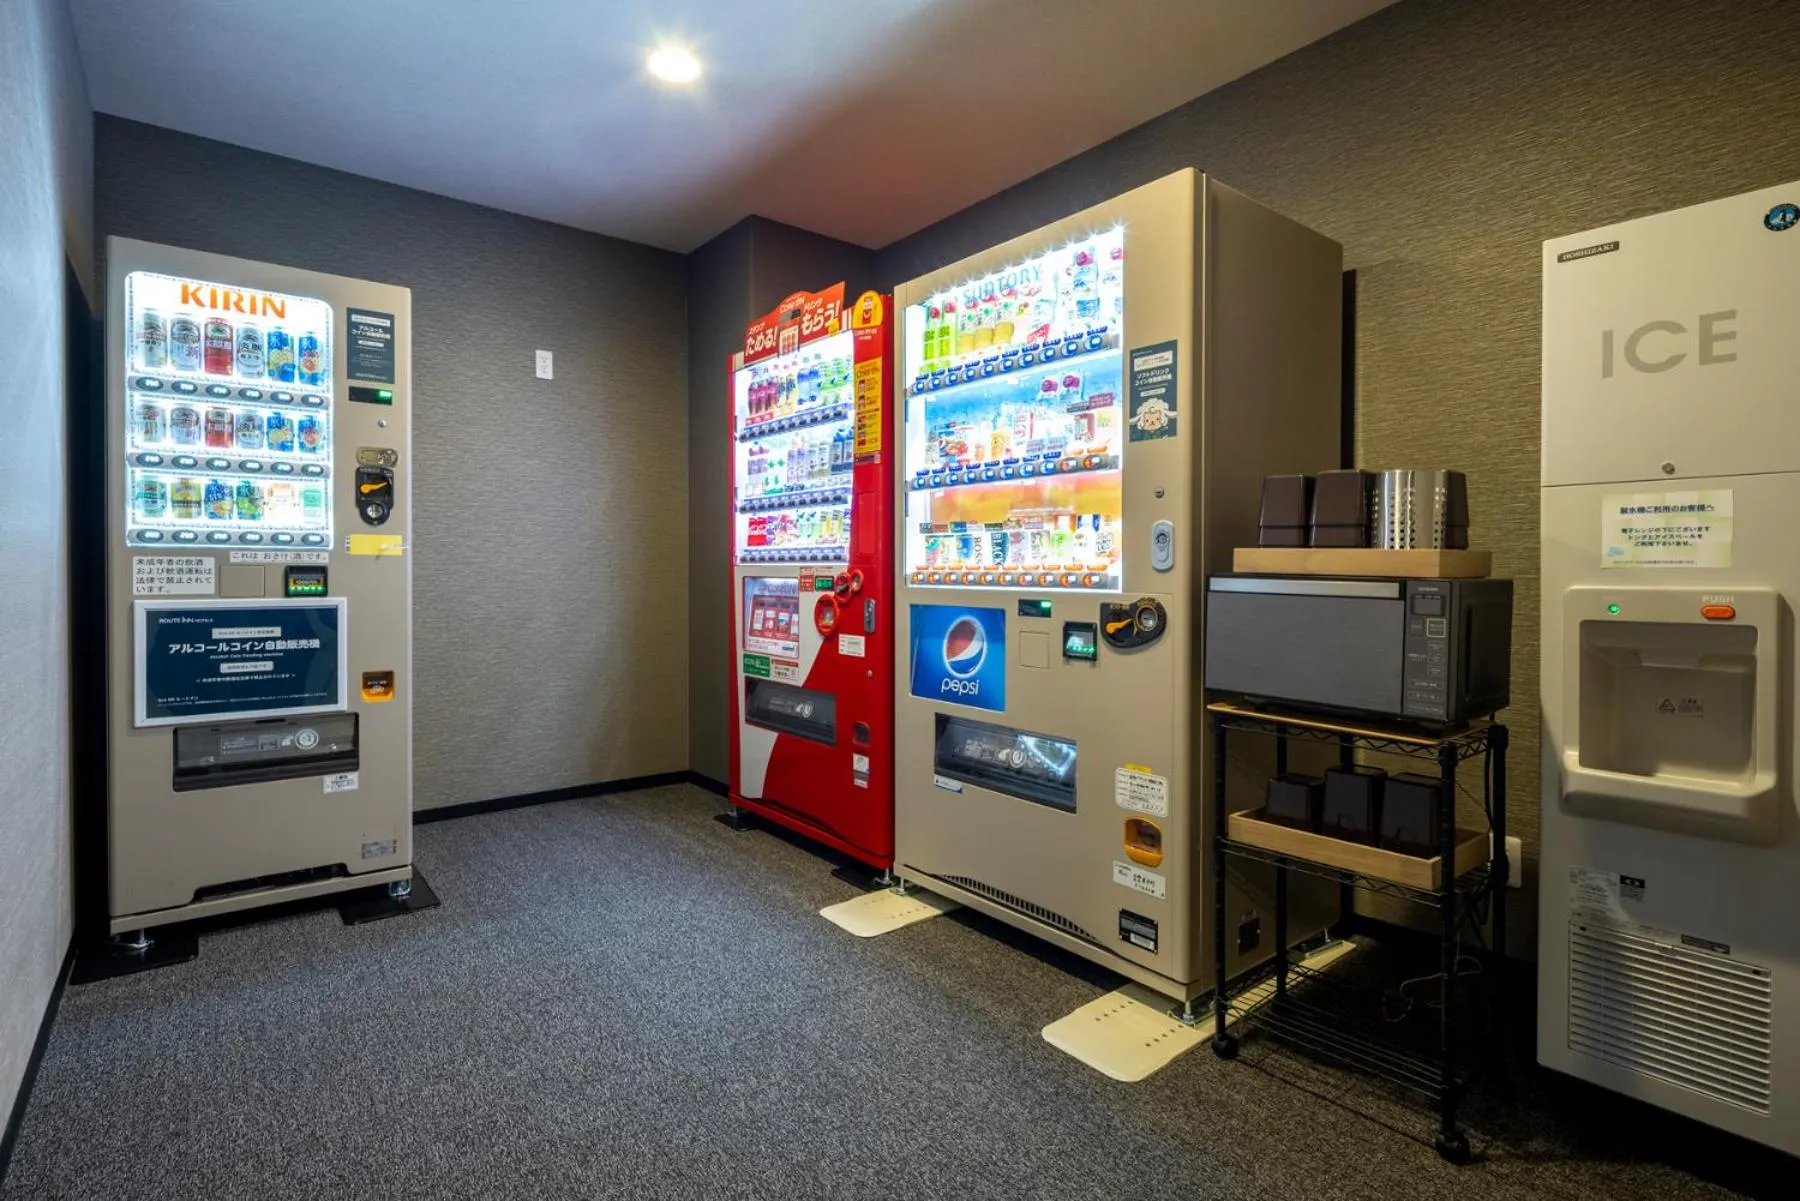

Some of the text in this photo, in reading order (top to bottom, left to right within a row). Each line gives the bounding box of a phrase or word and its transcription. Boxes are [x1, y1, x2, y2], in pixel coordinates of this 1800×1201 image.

[963, 265, 1041, 303] SUNTORY
[181, 282, 286, 319] KIRIN
[1602, 309, 1738, 379] ICE
[136, 576, 213, 585] 法律で禁止されて
[168, 638, 320, 655] アルコールコイン自動販売機
[941, 677, 979, 696] pepsi
